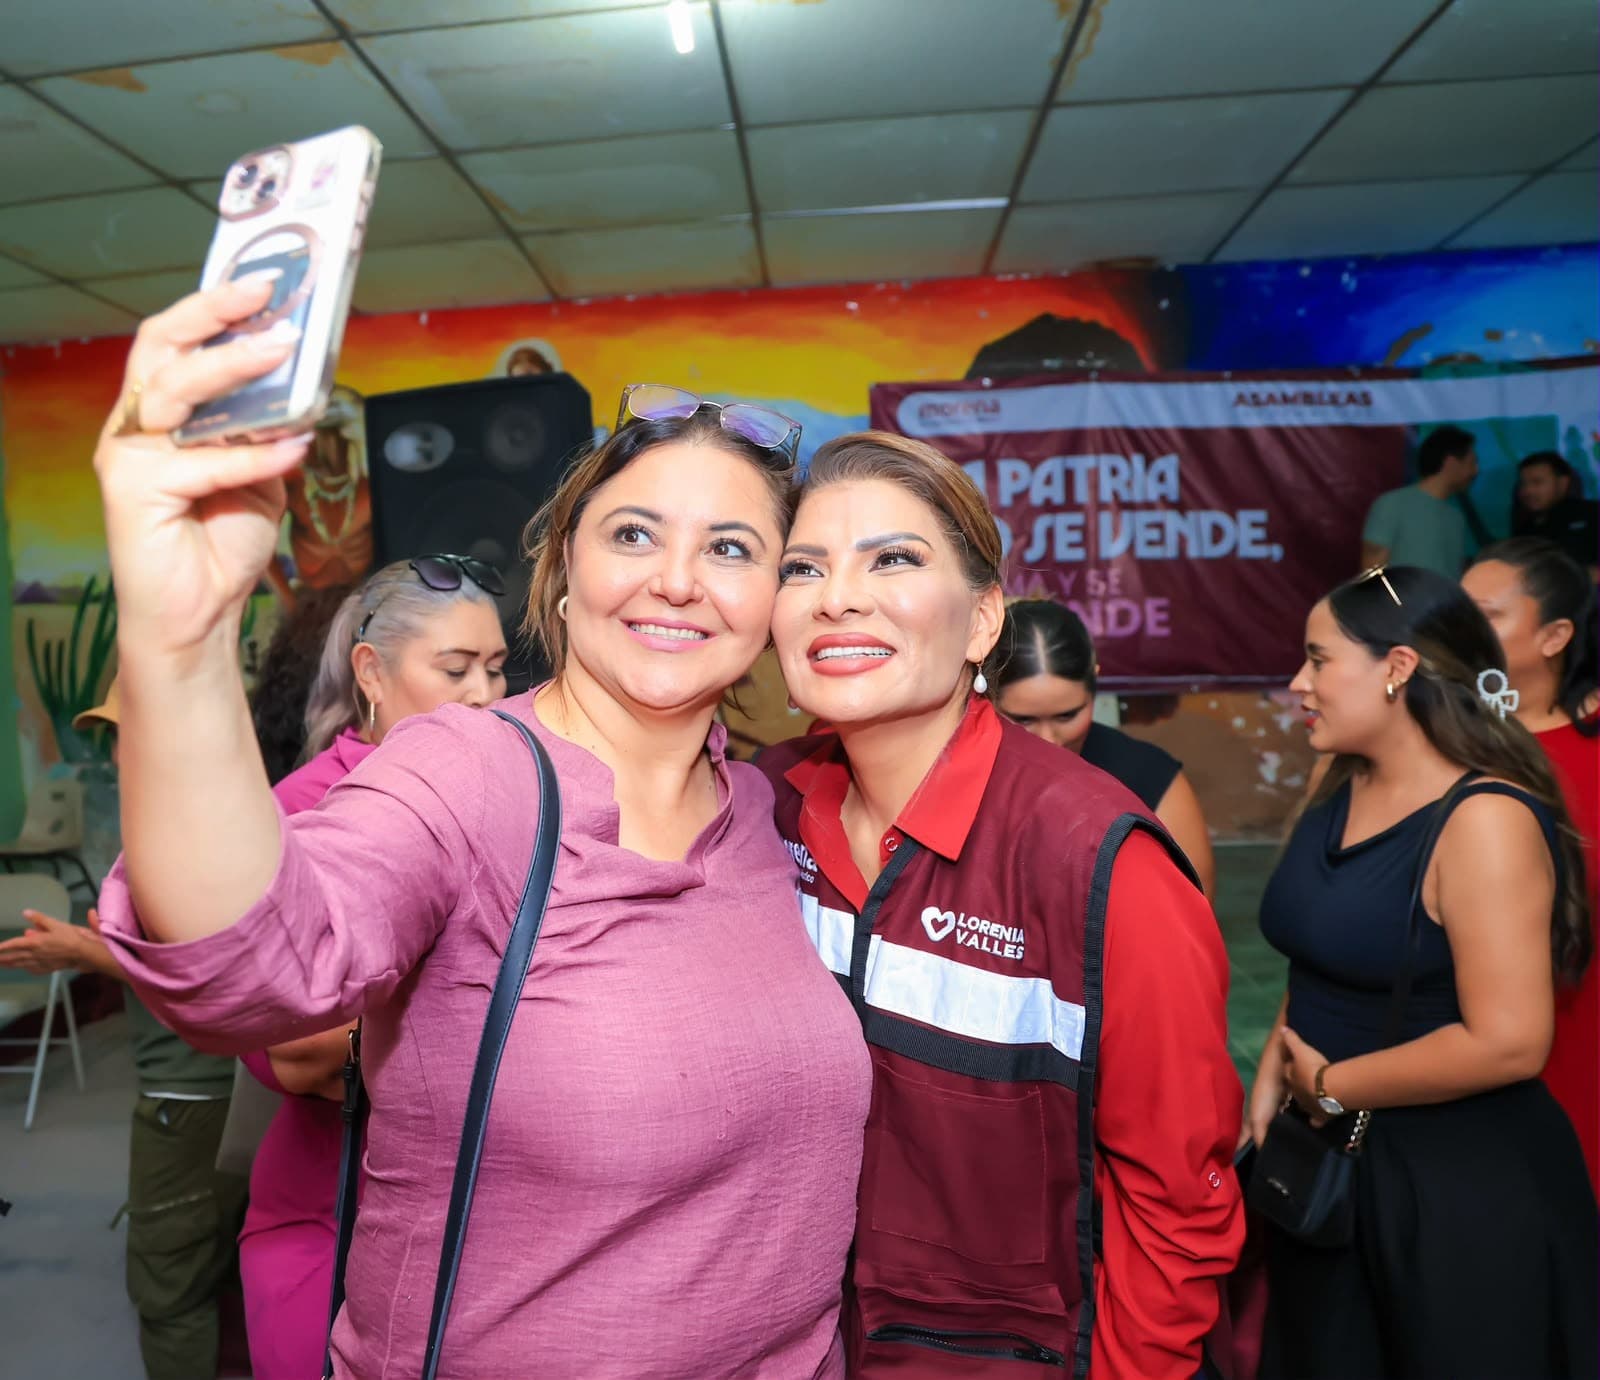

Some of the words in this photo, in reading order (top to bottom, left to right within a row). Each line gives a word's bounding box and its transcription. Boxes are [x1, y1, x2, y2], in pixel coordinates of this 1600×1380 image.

[1233, 391, 1373, 408] ASAMBLEAS
[996, 453, 1180, 507] PATRIA
[1023, 511, 1087, 563] SE
[1097, 509, 1284, 562] VENDE,
[1056, 570, 1078, 596] Y
[1066, 598, 1172, 638] NDE
[956, 928, 1025, 960] VALLES
[957, 912, 1025, 945] LORENIA
